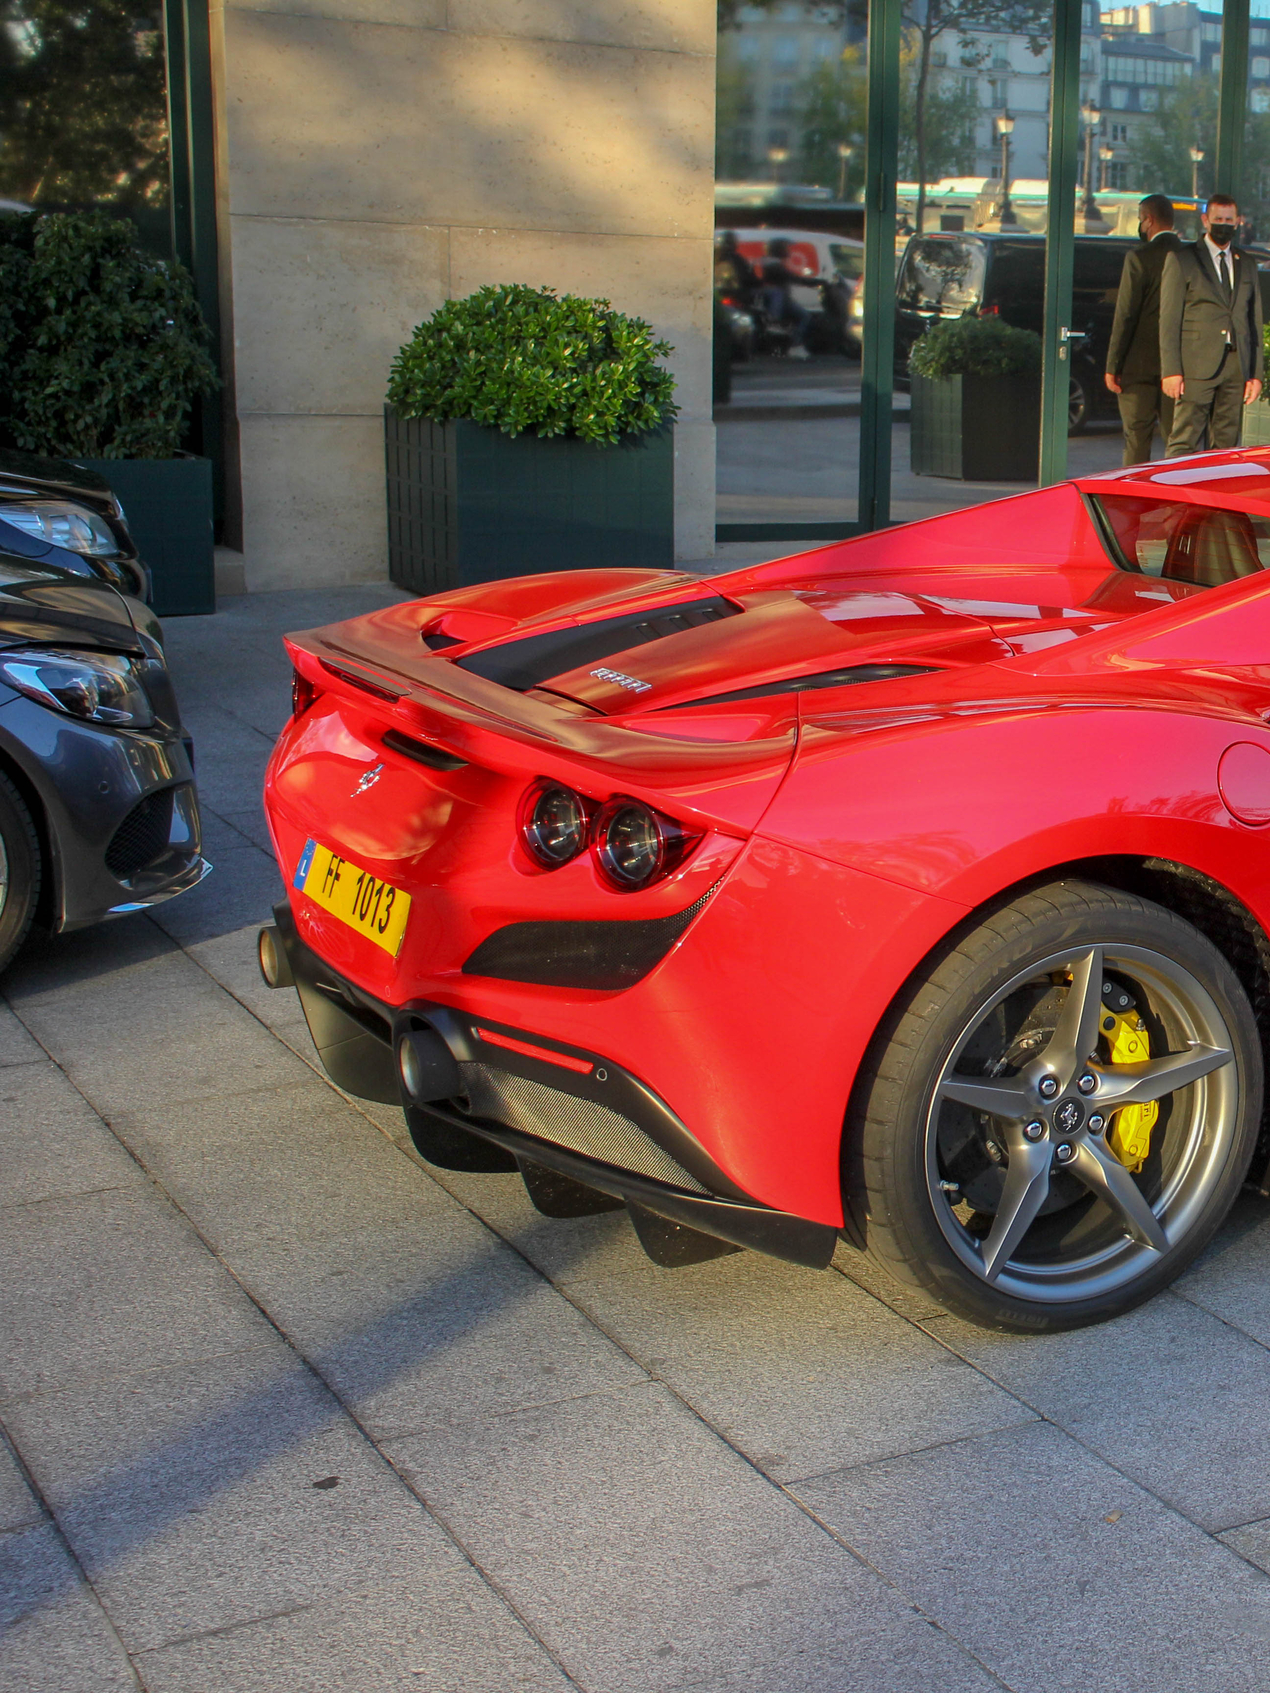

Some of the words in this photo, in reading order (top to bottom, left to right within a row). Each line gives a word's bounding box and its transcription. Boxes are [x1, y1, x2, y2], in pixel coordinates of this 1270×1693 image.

[300, 859, 307, 877] L
[322, 853, 346, 898] FF
[352, 871, 396, 934] 1013
